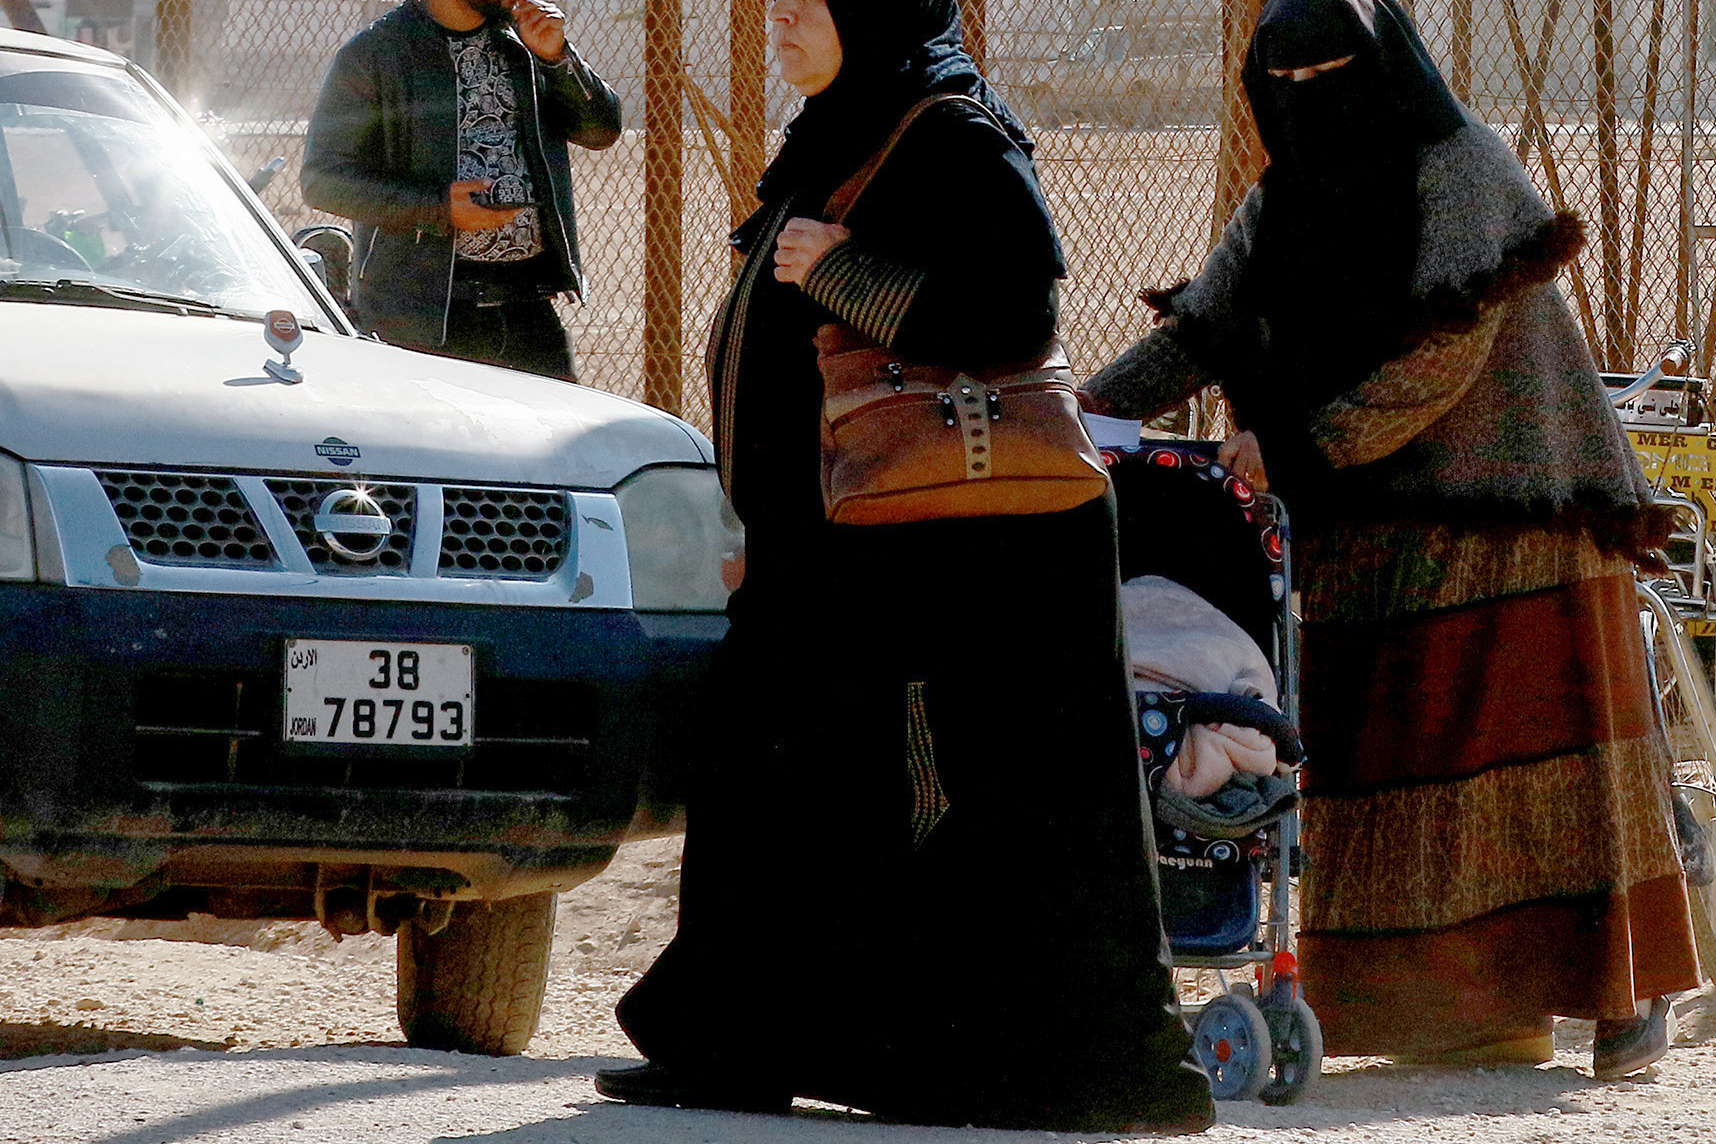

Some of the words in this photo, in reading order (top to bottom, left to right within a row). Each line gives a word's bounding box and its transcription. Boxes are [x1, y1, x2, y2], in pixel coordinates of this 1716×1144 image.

[316, 446, 359, 457] NISSAN
[369, 649, 419, 690] 38
[289, 717, 317, 737] JORDAN
[323, 697, 464, 741] 78793
